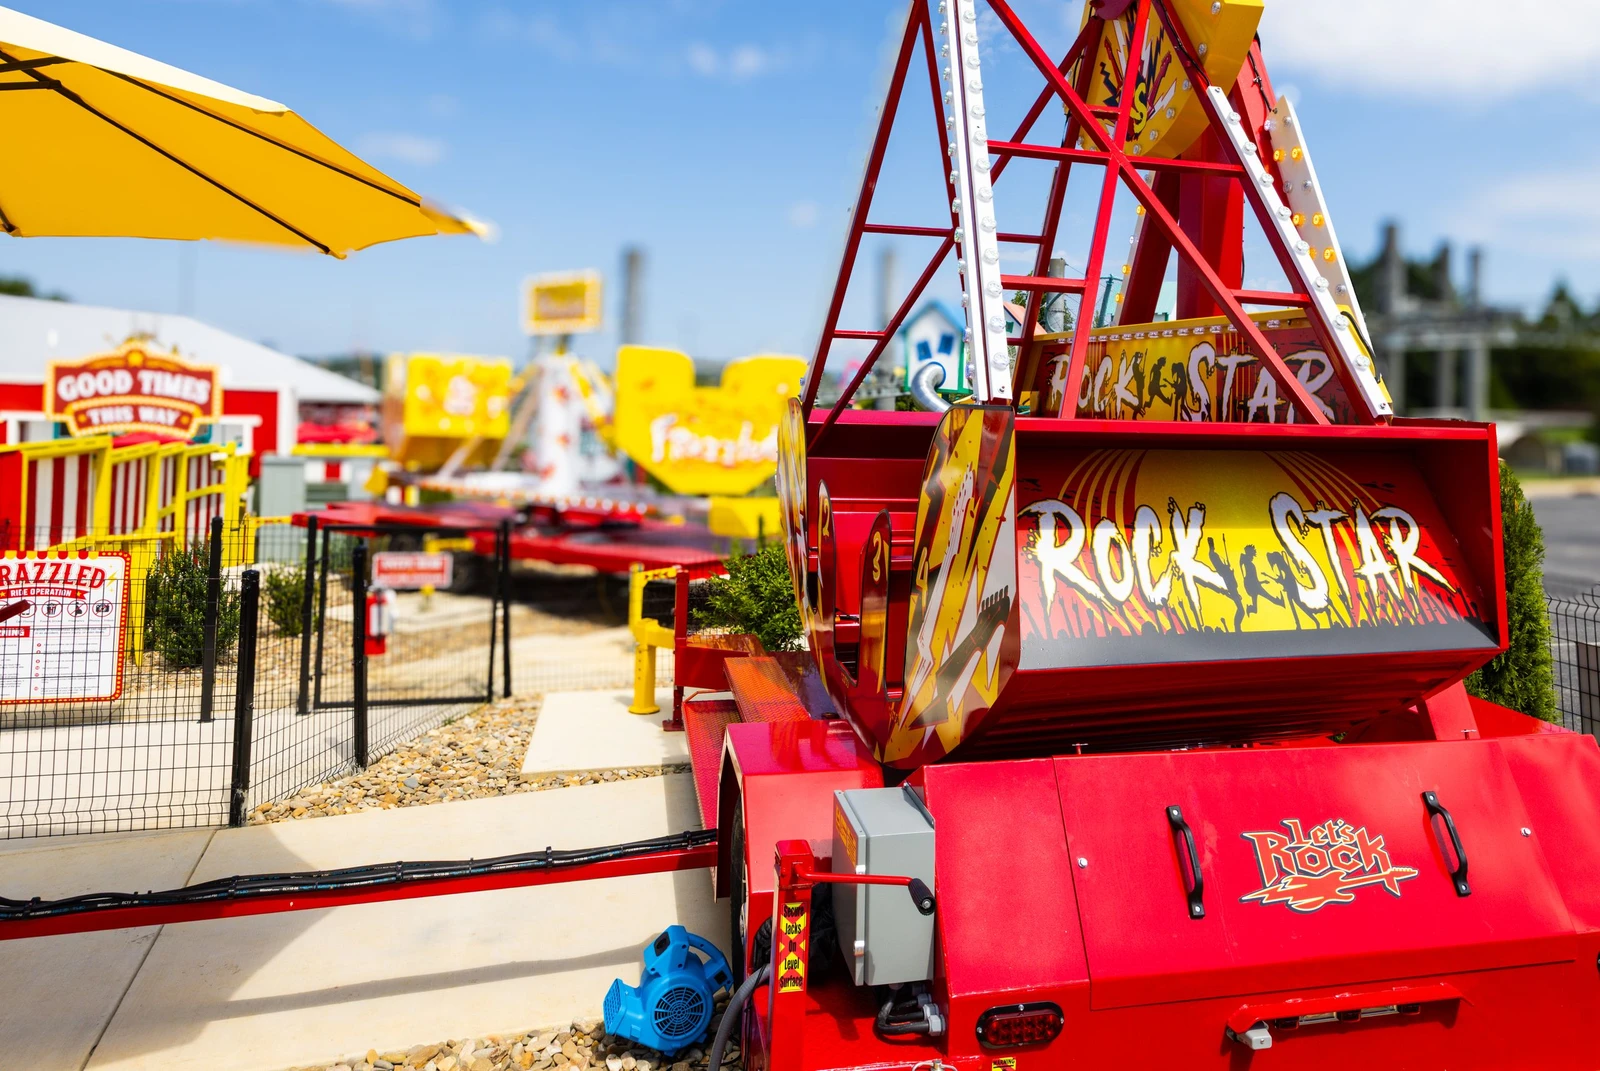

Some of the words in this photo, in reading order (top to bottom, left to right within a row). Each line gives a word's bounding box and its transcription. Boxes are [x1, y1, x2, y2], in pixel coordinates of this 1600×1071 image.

[57, 369, 133, 402] GOOD
[137, 369, 211, 404] TIMES
[1046, 349, 1140, 419] ROCK
[1181, 341, 1336, 424] STAR
[86, 405, 134, 425] THIS
[138, 406, 181, 426] WAY
[872, 531, 881, 582] 3
[1018, 496, 1230, 624] ROCK
[1268, 491, 1457, 615] STAR
[11, 588, 28, 597] RIDE
[30, 588, 72, 597] OPERATION
[0, 628, 25, 636] NING
[1283, 819, 1356, 846] Let's
[783, 904, 805, 917] Secure
[785, 922, 801, 935] Jacks
[788, 940, 797, 952] On
[784, 957, 800, 970] Level
[780, 974, 803, 988] Surface
